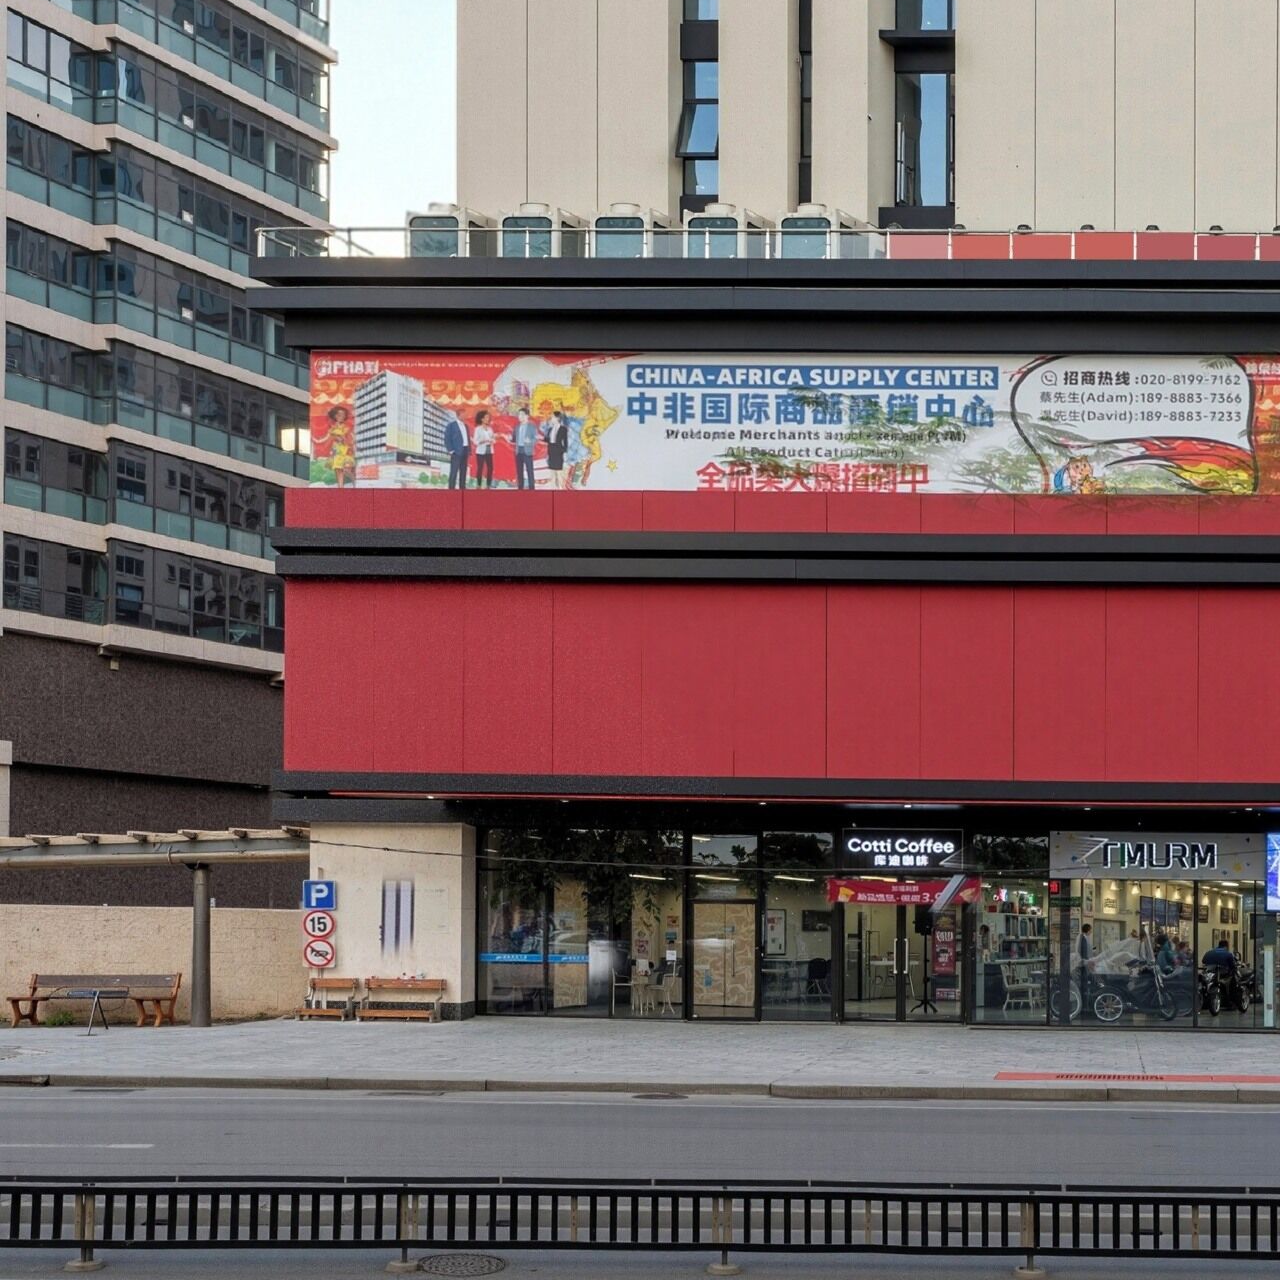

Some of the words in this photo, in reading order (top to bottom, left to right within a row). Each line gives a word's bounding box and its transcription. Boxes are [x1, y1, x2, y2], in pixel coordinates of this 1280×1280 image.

[630, 367, 804, 387] CHINA-AFRICA
[809, 367, 899, 387] SUPPLY
[905, 368, 994, 388] CENTER
[1063, 371, 1131, 386] 招商热线
[739, 429, 820, 442] Merchants
[847, 838, 892, 852] Cotti
[895, 838, 954, 853] Coffee
[310, 884, 329, 907] P
[309, 917, 327, 933] 15
